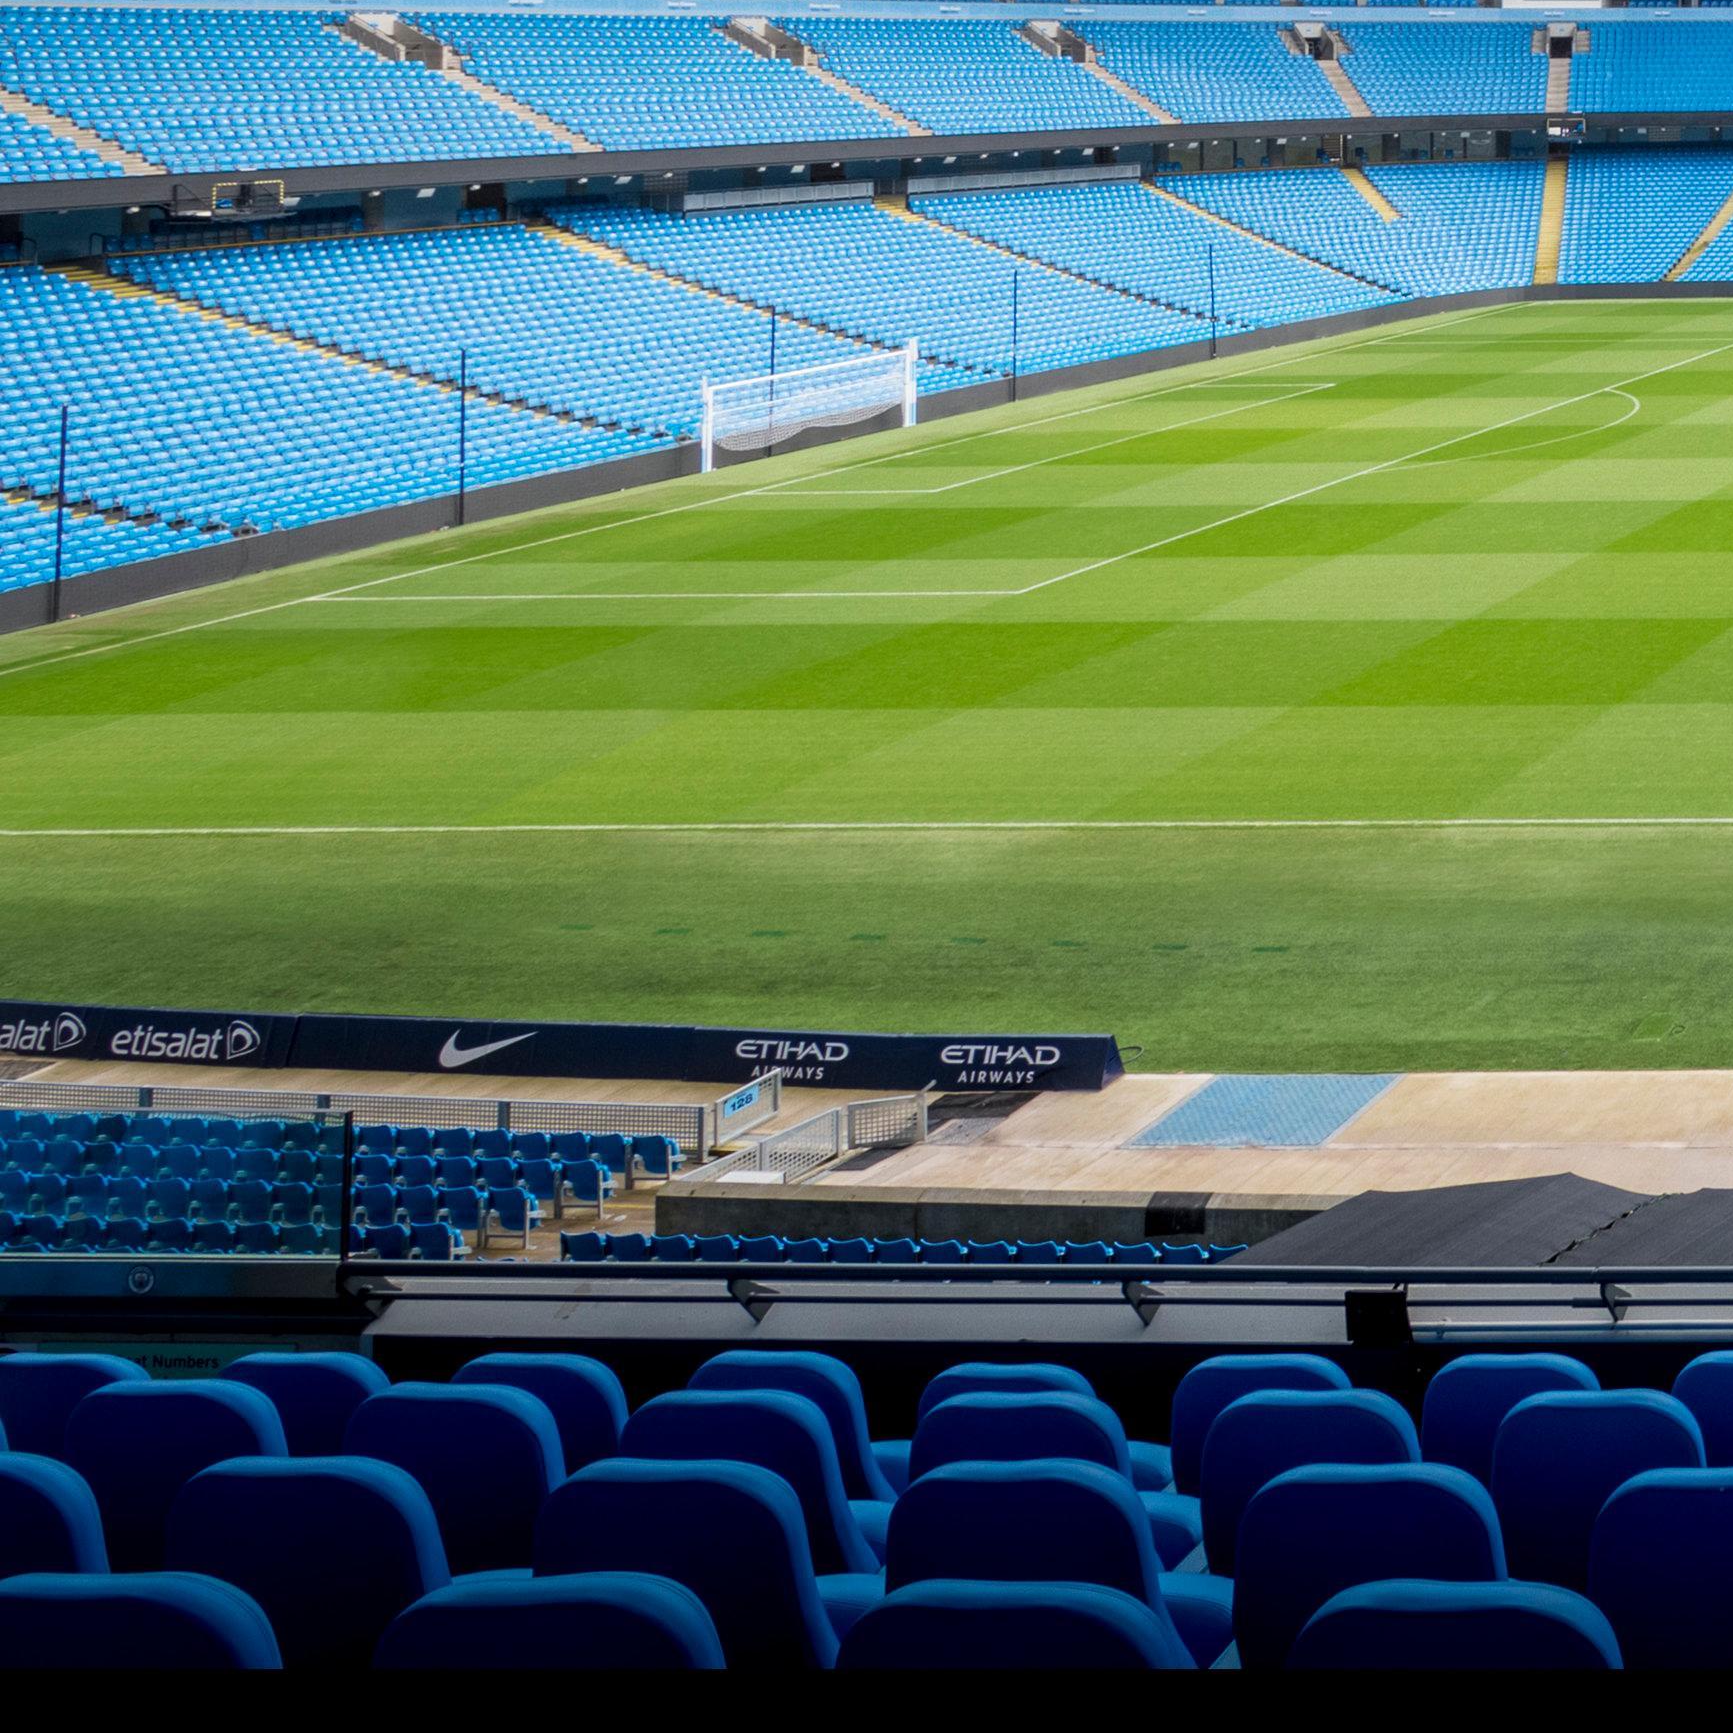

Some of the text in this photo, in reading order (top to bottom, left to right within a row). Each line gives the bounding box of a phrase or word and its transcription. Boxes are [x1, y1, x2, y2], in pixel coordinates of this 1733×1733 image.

[111, 1025, 222, 1059] etisalat
[735, 1039, 849, 1062] ETIHAD
[940, 1045, 1061, 1065] ETIHAD
[957, 1070, 1035, 1084] AIRWAYS
[730, 1093, 753, 1111] 128
[153, 1354, 220, 1369] Numbers
